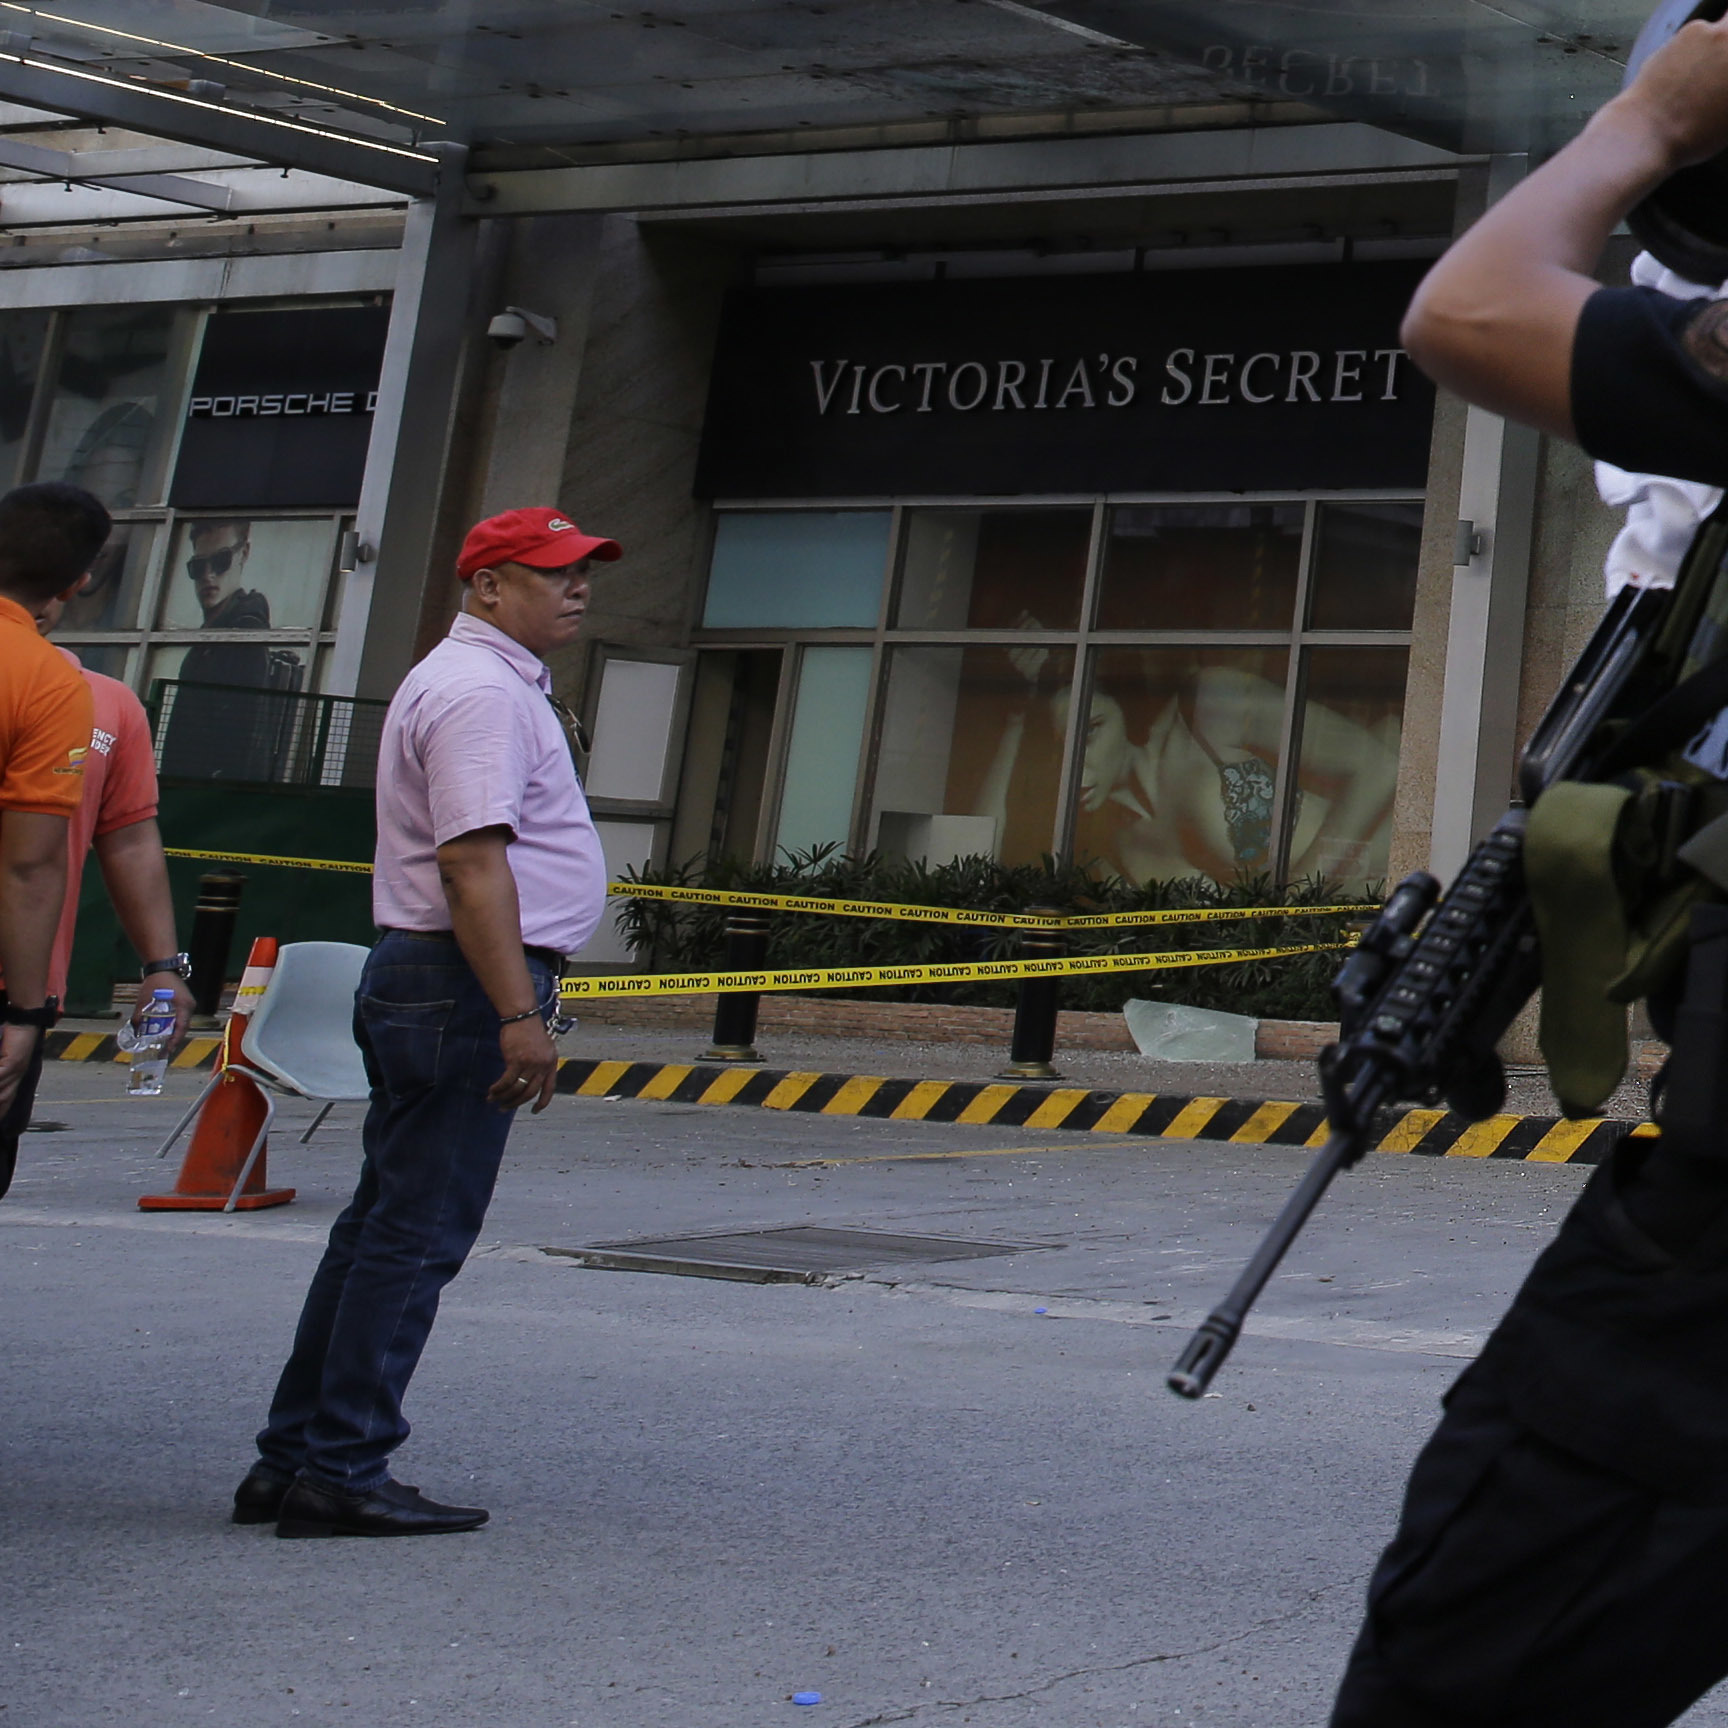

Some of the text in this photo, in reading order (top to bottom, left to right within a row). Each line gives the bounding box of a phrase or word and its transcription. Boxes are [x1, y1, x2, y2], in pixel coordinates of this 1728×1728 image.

[810, 347, 1411, 415] VICTORIA'S SECRET
[188, 392, 355, 417] PORSCHE
[613, 885, 664, 898] CAUTION
[671, 890, 721, 902] CAUTION
[728, 895, 779, 907] CAUTION
[785, 899, 835, 911] CAUTION
[843, 904, 893, 916] CAUTION
[899, 908, 949, 920] CAUTION
[956, 912, 1006, 924] CAUTION
[1067, 916, 1109, 926] CAUTION
[1115, 914, 1156, 925] CAUTION
[1161, 912, 1202, 922] CAUTION
[1207, 911, 1246, 920] CAUTION
[1069, 958, 1108, 970] CAUTION
[1113, 955, 1151, 967] CAUTION
[1155, 952, 1192, 964] CAUTION
[879, 967, 923, 980] CAUTION
[929, 965, 971, 978] CAUTION
[977, 963, 1019, 975] CAUTION
[1023, 961, 1064, 973] CAUTION
[717, 974, 767, 987] CAUTION
[773, 972, 821, 985] CAUTION
[827, 970, 873, 982] CAUTION
[598, 978, 652, 992] CAUTION
[659, 976, 711, 990] CAUTION
